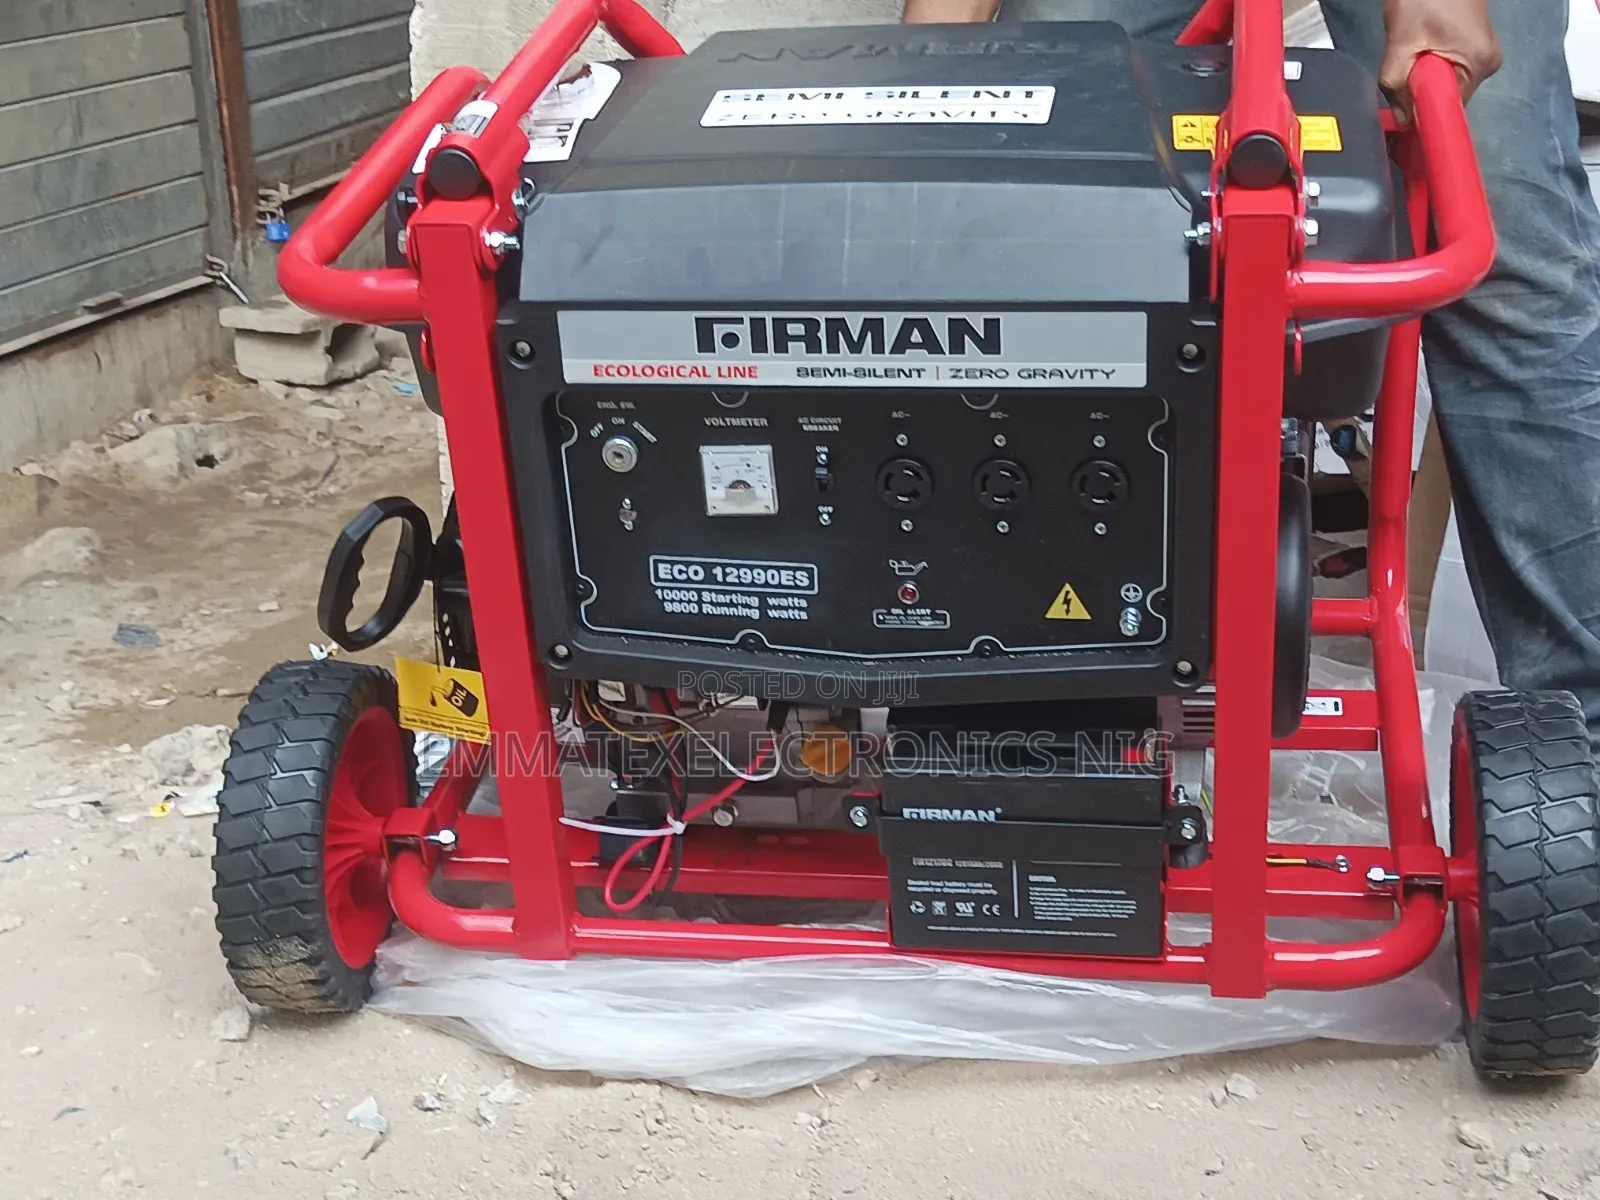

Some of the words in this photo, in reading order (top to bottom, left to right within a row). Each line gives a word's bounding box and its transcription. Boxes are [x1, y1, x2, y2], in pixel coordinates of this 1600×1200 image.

[693, 314, 1002, 357] FIRMAN
[593, 364, 711, 379] ECOLOGICAL
[717, 366, 759, 379] LINE
[796, 366, 927, 379] SEMI-SILENT
[949, 367, 1010, 380] ZERO
[1017, 368, 1117, 381] GRAVITY
[610, 416, 626, 426] ON
[703, 417, 769, 427] VOLTMETER
[657, 562, 705, 581] ECO
[711, 565, 810, 587] 12990ES
[654, 588, 699, 602] 10000
[701, 591, 760, 608] Starting
[766, 596, 808, 608] watts
[663, 601, 699, 614] 9800
[701, 604, 760, 620] Running
[767, 608, 809, 621] watts
[451, 688, 468, 707] OIL
